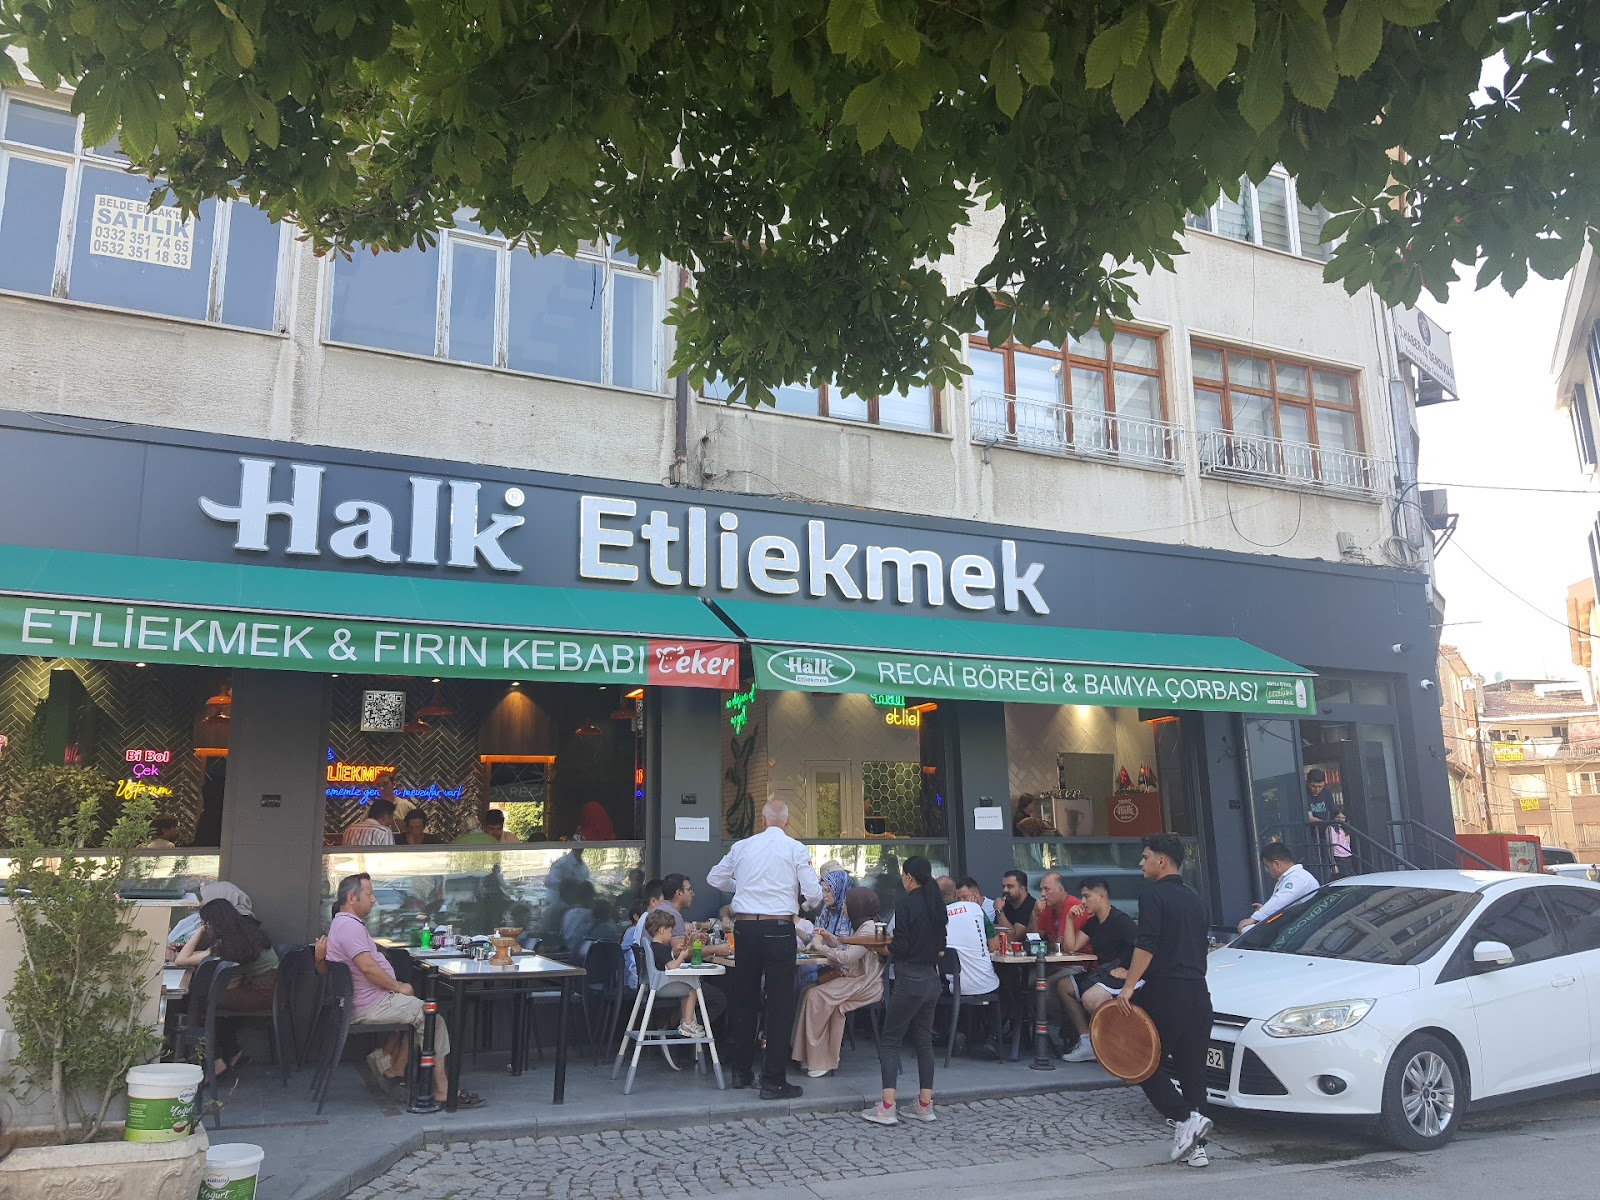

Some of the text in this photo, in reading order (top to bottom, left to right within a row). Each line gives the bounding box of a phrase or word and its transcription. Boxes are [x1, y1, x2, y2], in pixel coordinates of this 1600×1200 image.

[99, 197, 133, 212] BELDE
[97, 208, 190, 238] SATILIK
[93, 239, 188, 266] 0532 351 18 33
[95, 225, 189, 253] 0332 351 74 65
[198, 457, 1051, 615] Halk Etliekmek
[21, 607, 645, 674] ETLİEKMEK & FIRIN KEBABI
[784, 656, 839, 679] Halk
[878, 661, 1259, 703] RECAİ BÖREĞİ & BAMYA ÇORBASI
[125, 749, 170, 763] Bi Bol
[132, 763, 159, 779] Çek
[1208, 1050, 1222, 1067] 82
